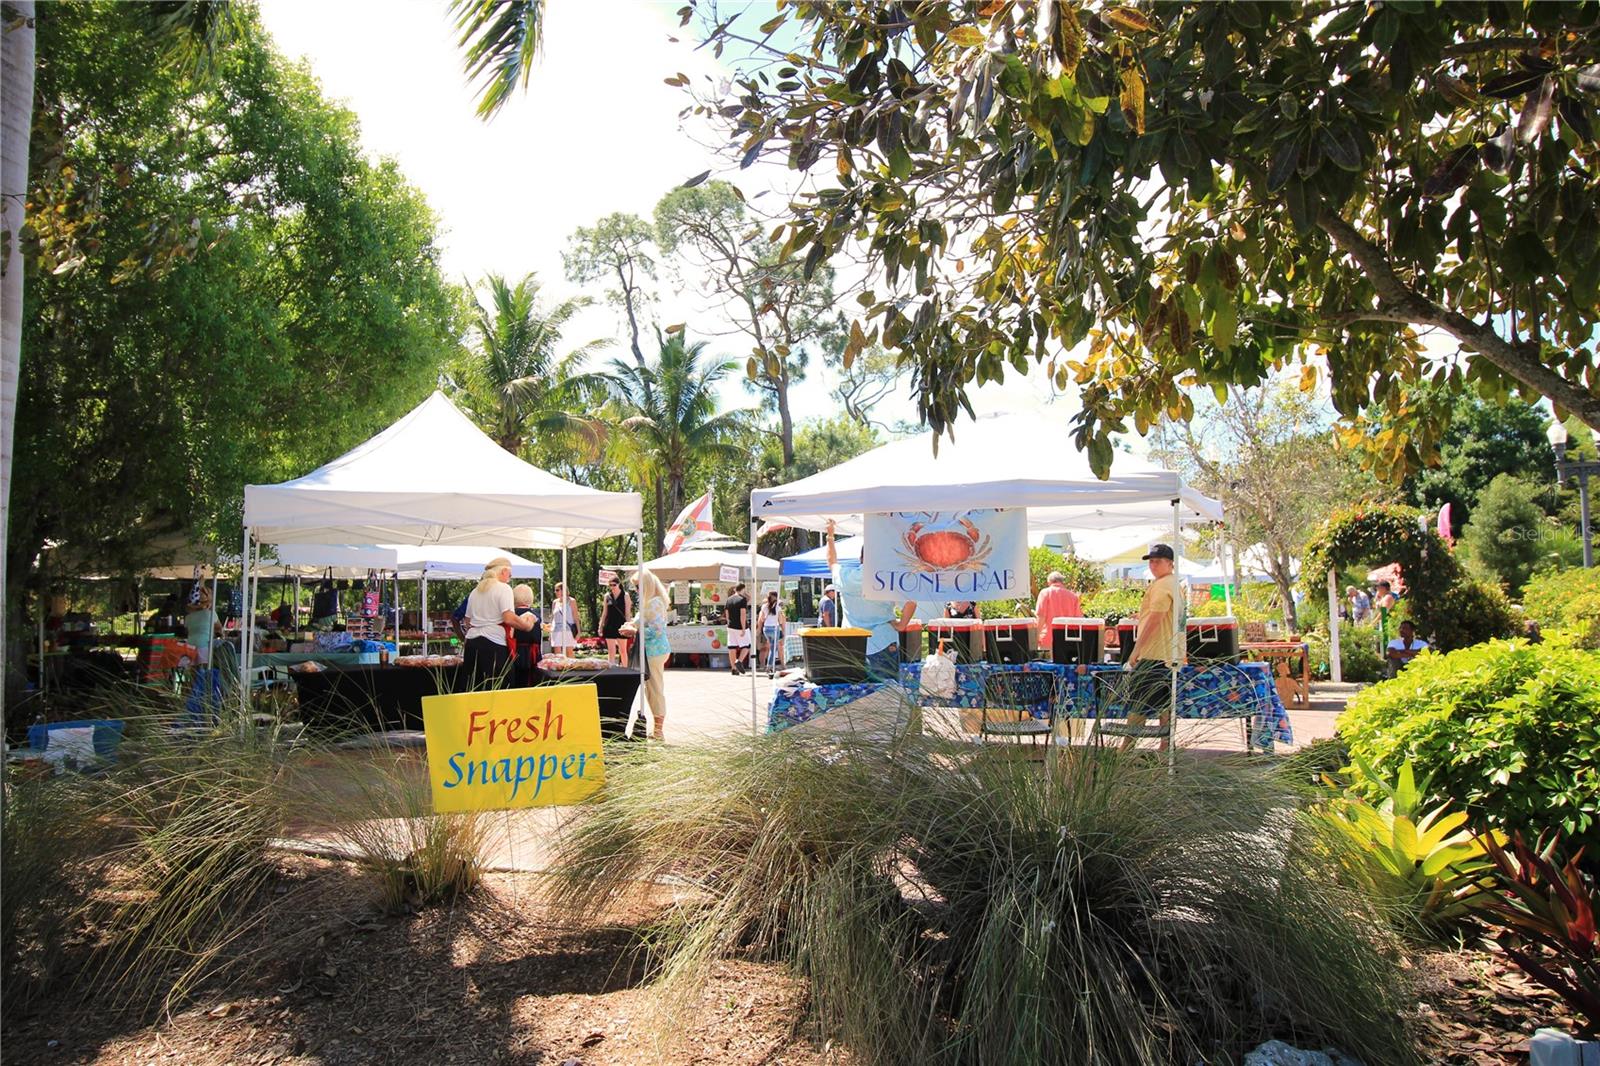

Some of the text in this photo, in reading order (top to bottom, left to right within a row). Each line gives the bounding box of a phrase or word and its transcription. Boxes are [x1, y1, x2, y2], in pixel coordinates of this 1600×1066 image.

[873, 569, 1016, 593] STONE CRAB
[467, 699, 566, 746] Fresh
[443, 752, 597, 801] Snapper
